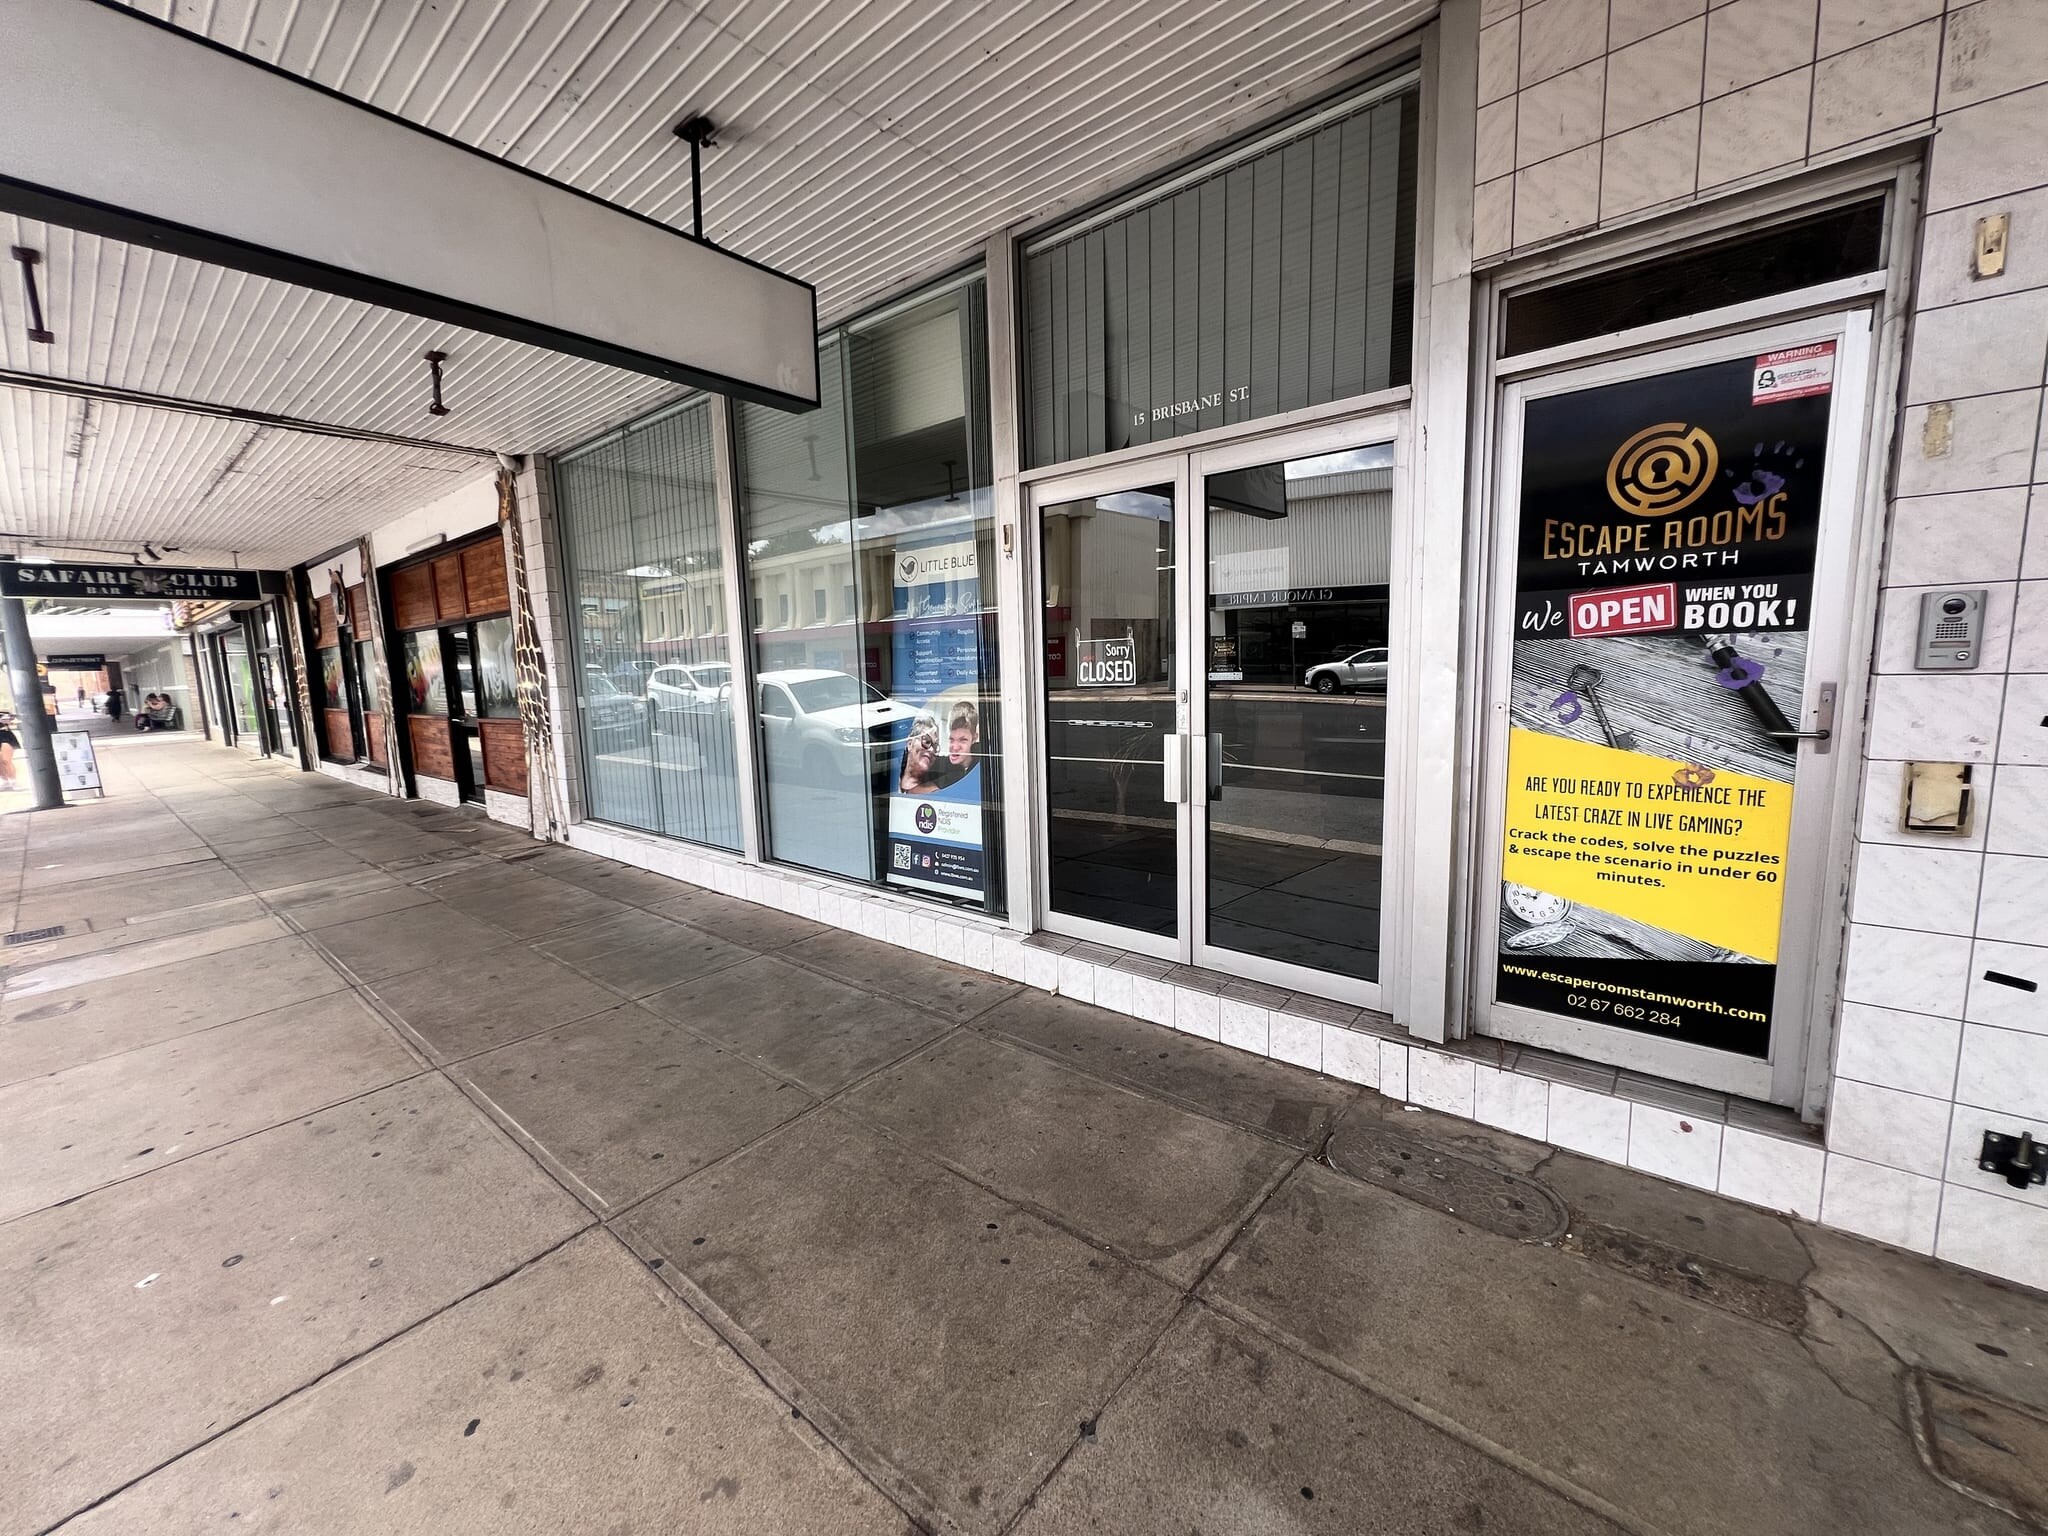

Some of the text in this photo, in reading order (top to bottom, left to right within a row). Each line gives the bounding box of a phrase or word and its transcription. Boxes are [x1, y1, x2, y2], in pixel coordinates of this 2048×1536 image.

[1767, 344, 1823, 362] WARNING
[1781, 370, 1829, 385] SECURITY
[1133, 386, 1250, 426] 15 BRISBANE ST.
[1543, 491, 1788, 560] ESCAPE ROOMS
[920, 553, 976, 573] LITTLE BLUE
[1578, 550, 1740, 576] TAMWORTH
[17, 568, 238, 588] SAFARI CLUB
[86, 586, 121, 595] BAR
[164, 588, 211, 597] GRILL
[1521, 583, 1779, 631] We OPEN WHEN YOU
[1683, 599, 1797, 630] BOOK!
[1105, 643, 1130, 659] Sorry
[1079, 660, 1133, 682] CLOSED
[1525, 776, 1767, 808] ARE YOU READY TO EXPERIENCE THE
[918, 820, 934, 831] ndis
[938, 808, 969, 820] Registered
[1535, 803, 1743, 837] LATEST CRAZE IN LIVE GAMING?
[1509, 828, 1781, 865] Crack the codes, solve the puzzles
[1508, 843, 1778, 883] & escape the scenario in under 60
[1596, 871, 1666, 888] minutes.
[1502, 962, 1768, 1023] www.escaperoomstamworth.com
[1567, 993, 1682, 1028] 02 67 662 284
